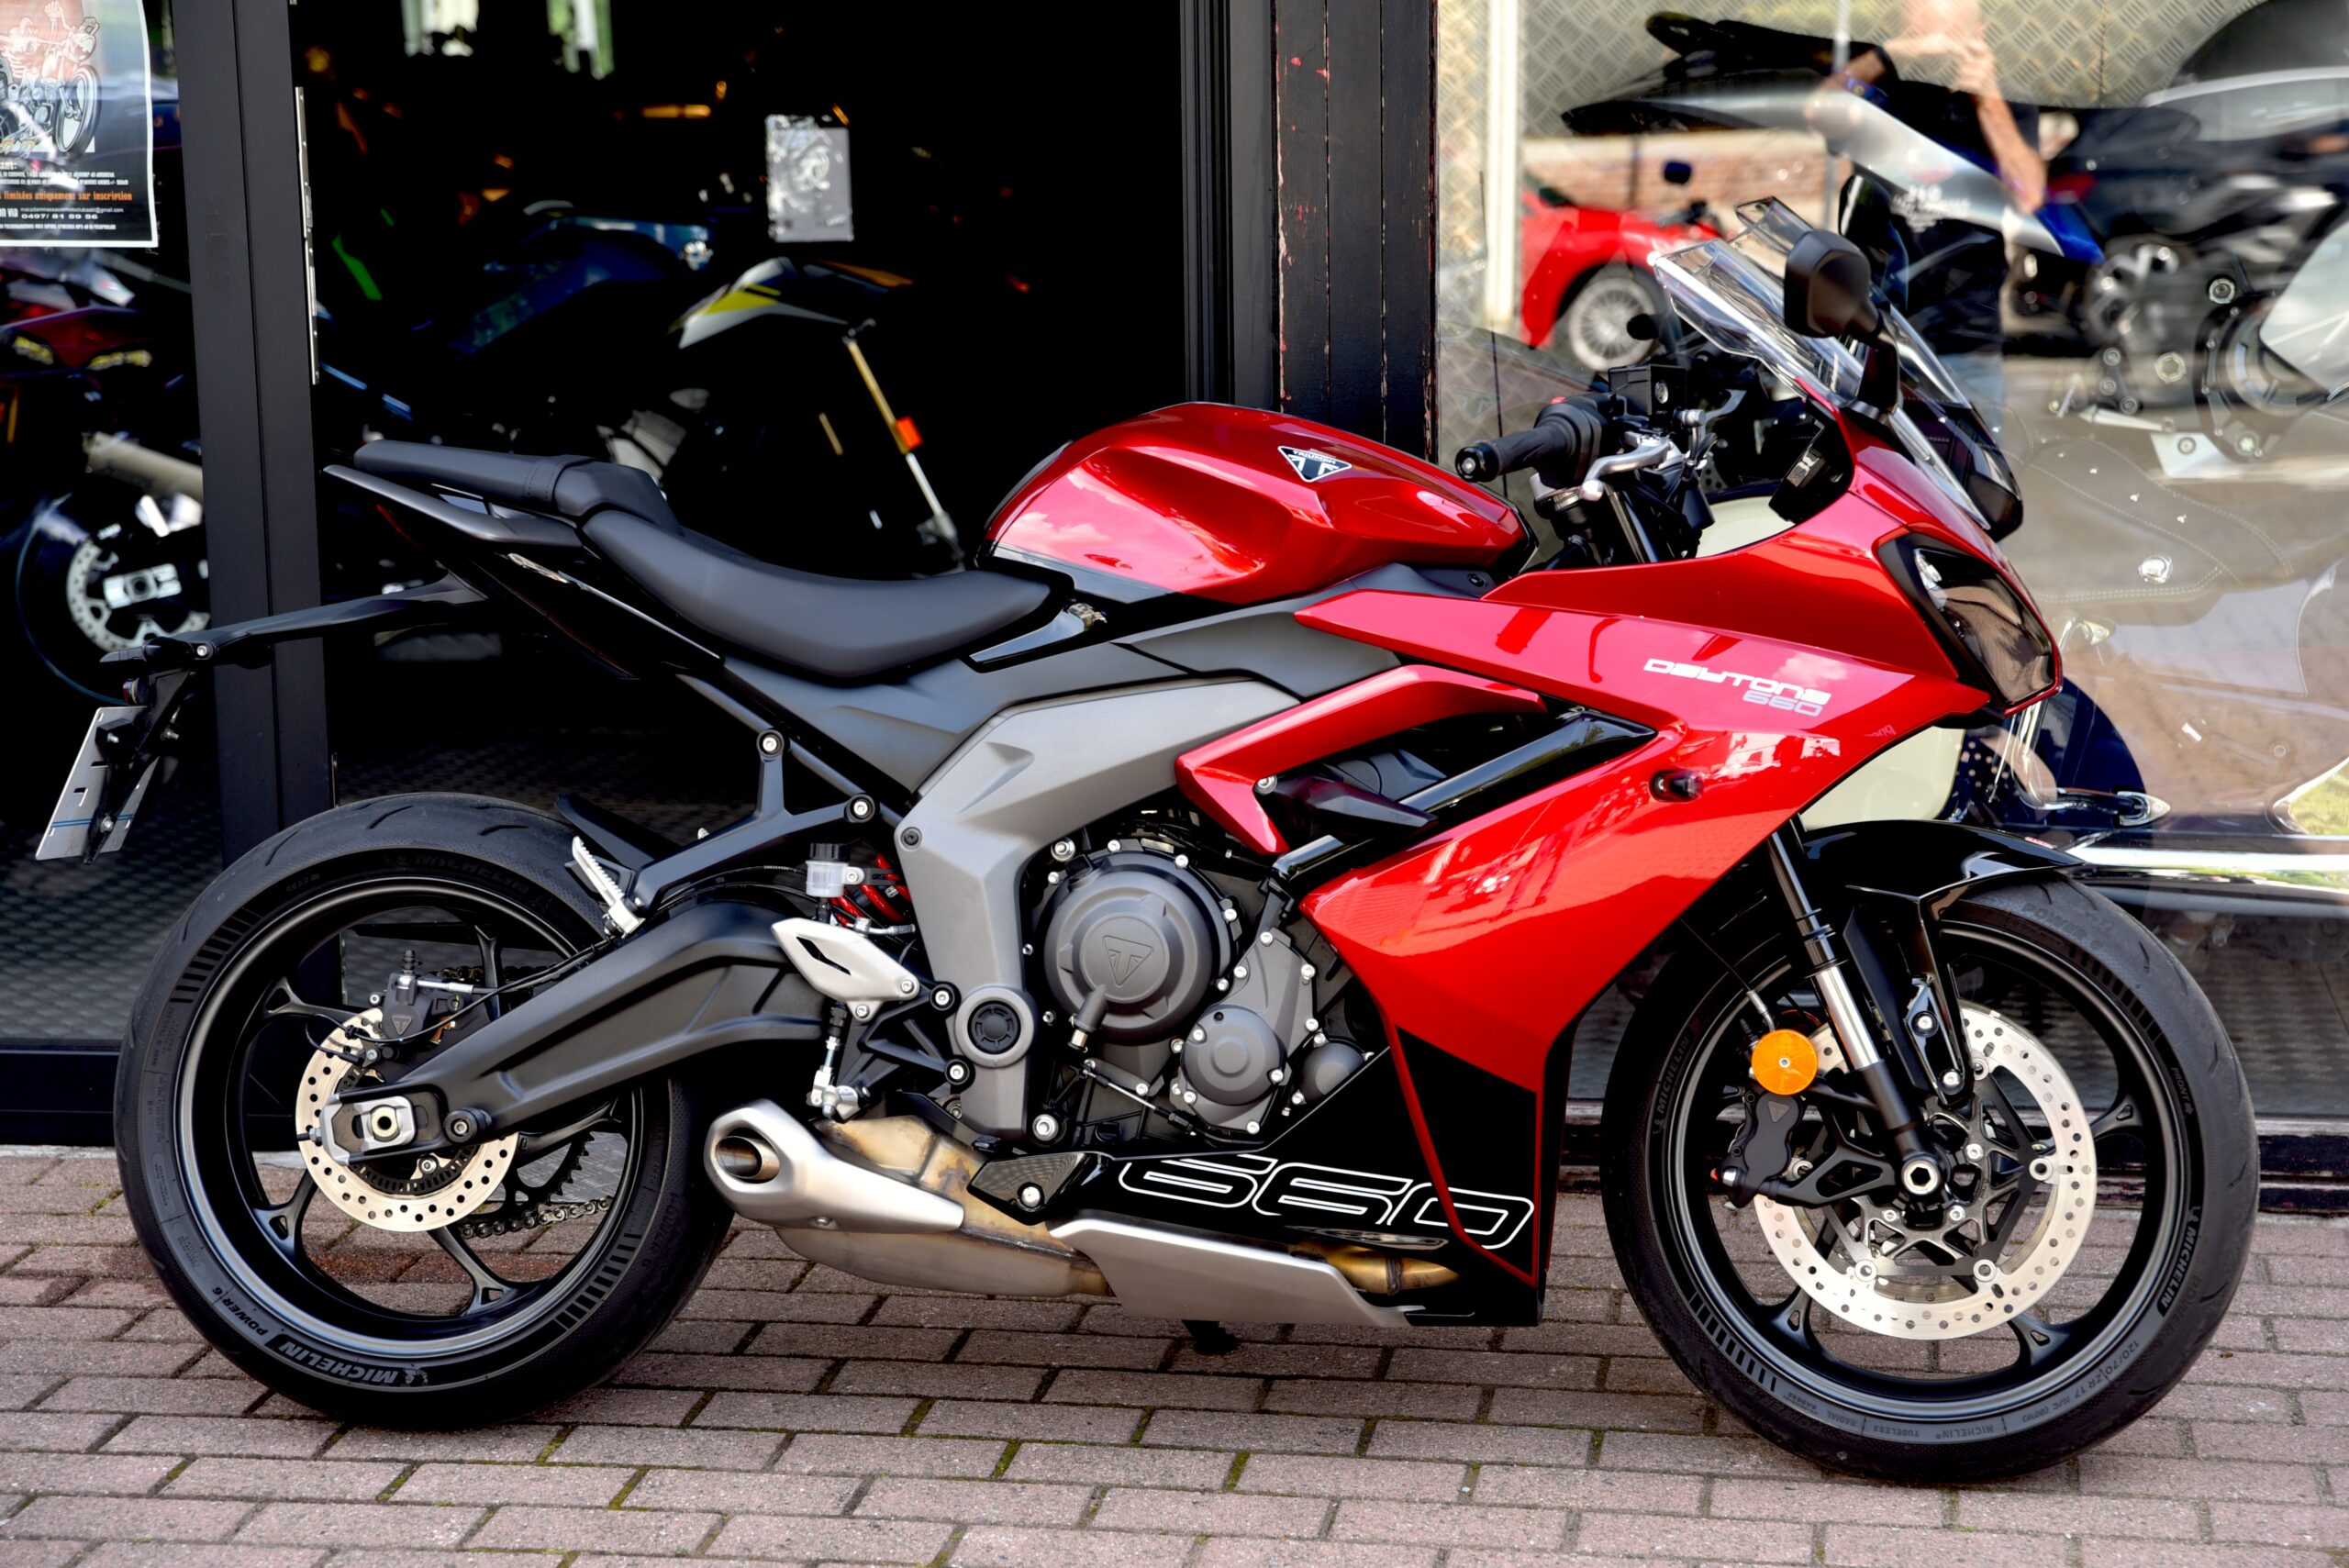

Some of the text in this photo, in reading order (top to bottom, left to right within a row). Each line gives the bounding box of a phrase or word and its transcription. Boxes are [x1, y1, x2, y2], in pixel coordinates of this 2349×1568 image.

[78, 192, 92, 201] sur
[94, 190, 133, 201] inscription
[1292, 450, 1337, 464] TRIUMPH
[1742, 689, 1823, 717] 660
[1656, 1036, 1689, 1115] MICHELIN
[1119, 1153, 1535, 1250] 660
[2160, 1226, 2197, 1309] MICHELIN
[211, 1285, 269, 1337] POWER 6
[278, 1340, 400, 1385] MICHELIN
[2105, 1340, 2140, 1375] 120/70
[1827, 1409, 1858, 1428] RADIAL
[1873, 1424, 1920, 1438] TUBELESS
